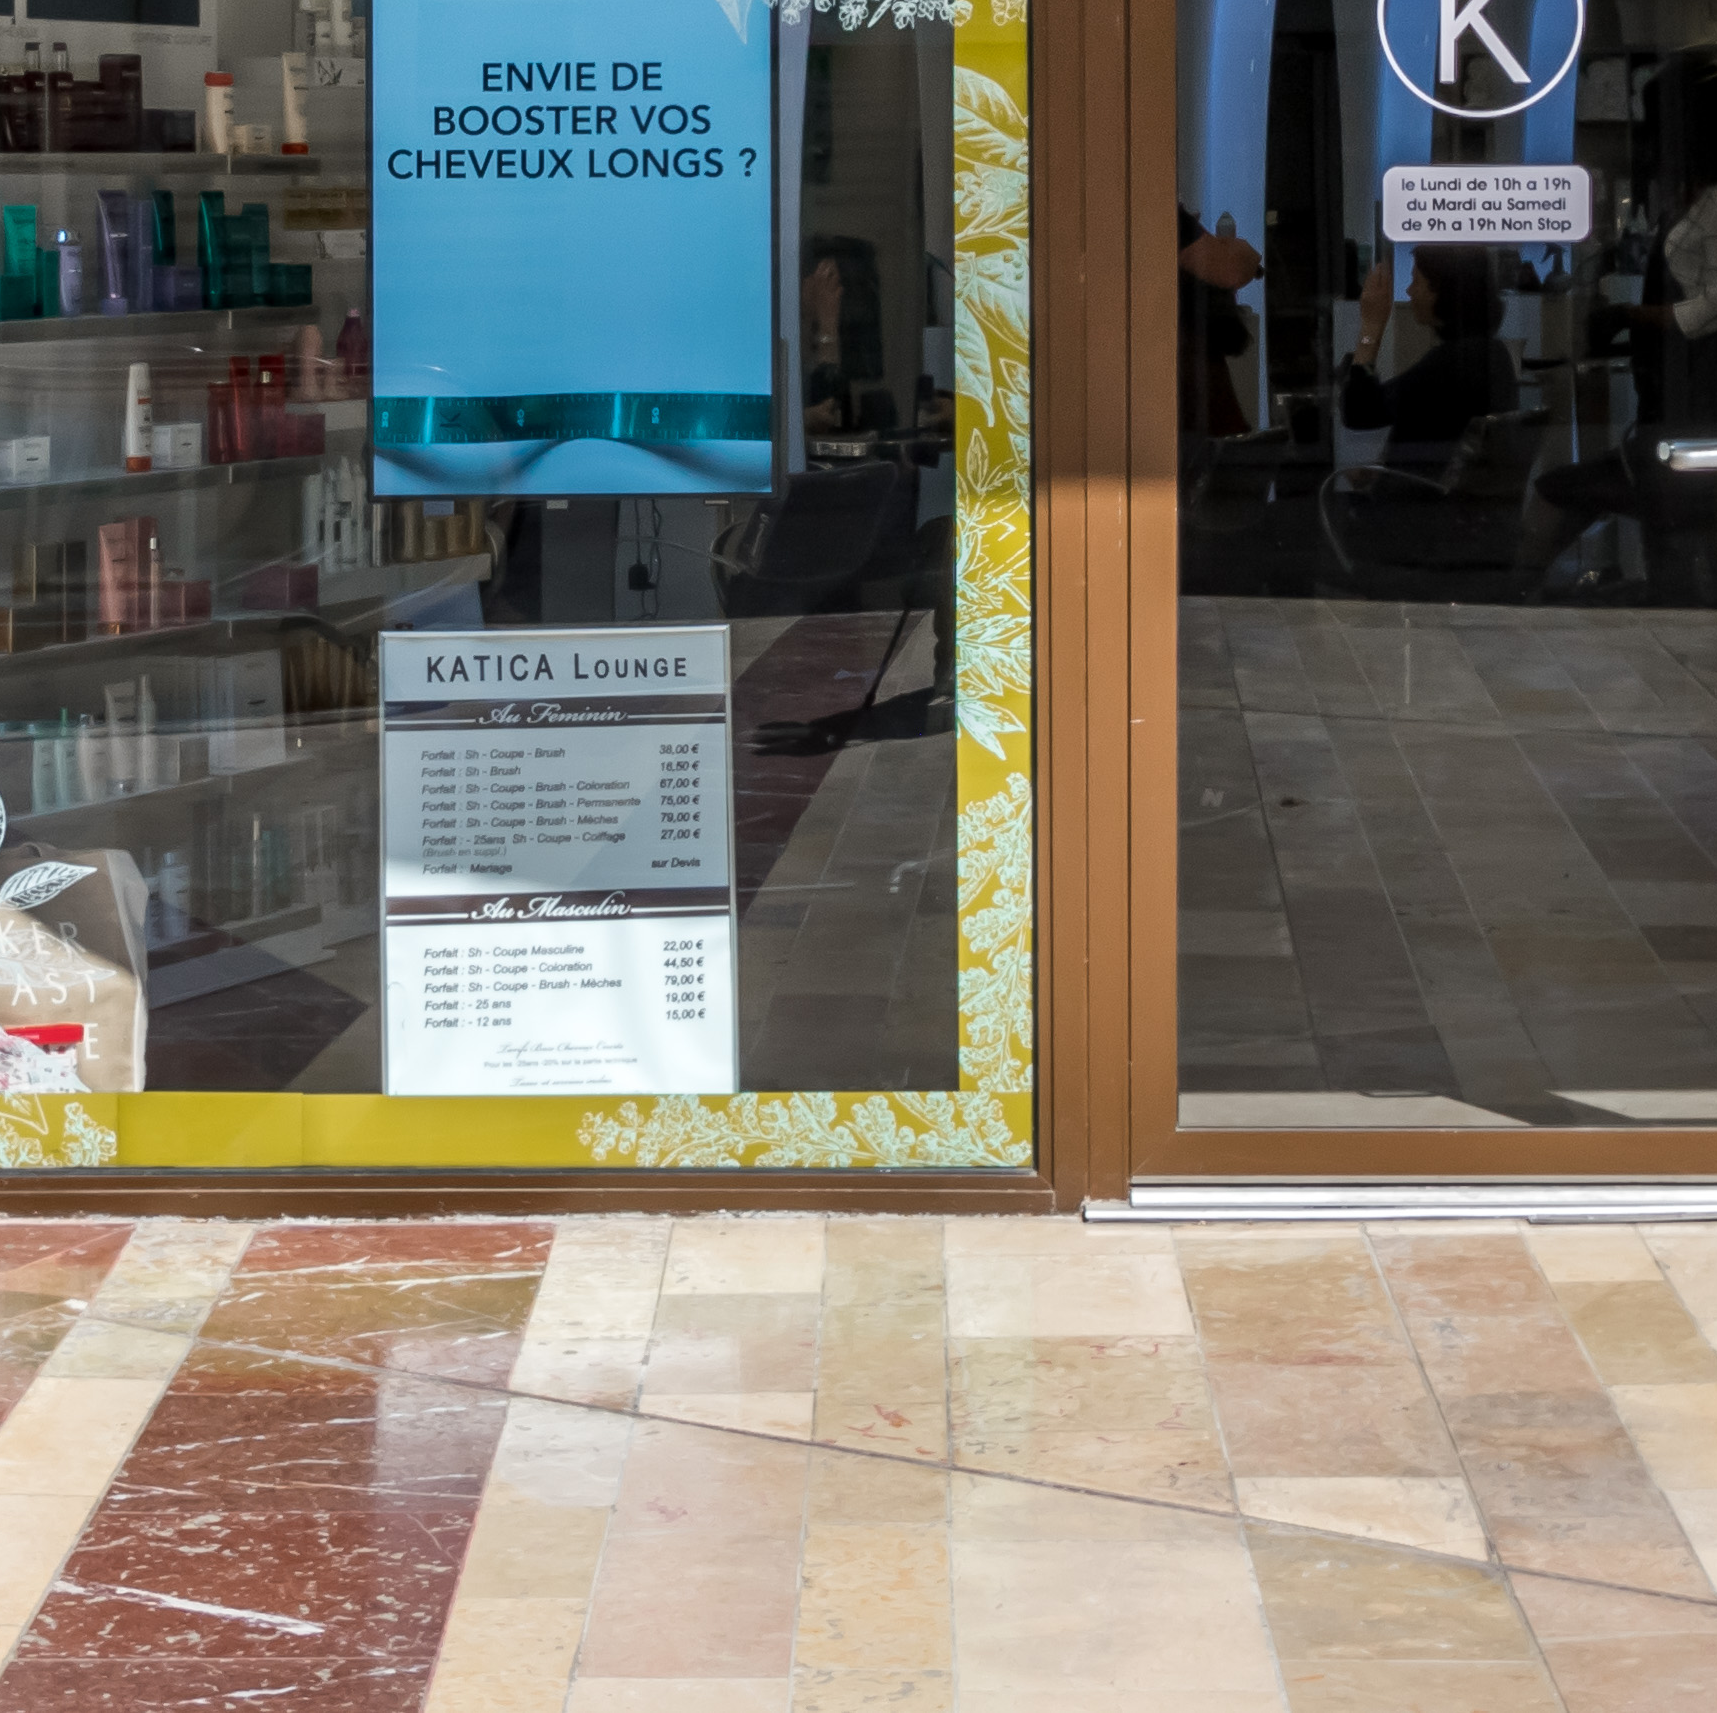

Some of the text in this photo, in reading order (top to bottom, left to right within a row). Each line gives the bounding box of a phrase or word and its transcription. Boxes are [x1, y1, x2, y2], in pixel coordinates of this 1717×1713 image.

[482, 61, 663, 92] ENVIE DE
[433, 104, 712, 136] BOOSTER VOS
[387, 148, 758, 180] CHEVEUX LONGS ?
[1402, 177, 1571, 191] le Lundi de 10h a 19h
[1406, 197, 1566, 211] du Mardi au Samedi
[1402, 217, 1572, 233] de 9h a 19h Non Stop
[427, 653, 687, 683] KATICA LOUNGE
[479, 702, 521, 725] Au
[421, 750, 455, 761] Forfait
[465, 749, 479, 760] Sh
[490, 748, 524, 761] Coupe
[534, 747, 565, 758] Brush
[421, 767, 456, 778] Forfait
[465, 766, 479, 777] Sh
[490, 765, 521, 777] Brush
[421, 784, 456, 795] Forfait
[465, 783, 480, 794] Sh
[490, 782, 525, 795] Coupe
[535, 781, 566, 793] Brush
[422, 801, 456, 812] Forfait
[466, 800, 480, 811] Sh
[490, 799, 525, 812] Coupe
[535, 798, 566, 810] Brush
[422, 818, 456, 829] Forfait
[466, 817, 481, 828] Sh
[490, 816, 526, 829] Coupe
[536, 815, 567, 826] Brush
[422, 835, 456, 846] Forfait
[513, 833, 527, 844] Sh
[537, 832, 571, 844] Coupe
[423, 857, 701, 875] Forfait Mariage sur Devis
[471, 890, 631, 920] Au Masculin
[424, 948, 458, 959] Forfait
[468, 947, 482, 958] Sh
[492, 946, 527, 958] Coupe
[531, 944, 584, 955] Masculine
[663, 940, 693, 952] 22,00
[424, 965, 458, 976] Forfait
[468, 964, 482, 975] Sh
[493, 964, 528, 976] Coupe
[538, 962, 593, 972] Coloration
[424, 983, 458, 993] Forfait
[468, 982, 482, 992] Sh
[493, 981, 528, 993] Coupe
[539, 979, 570, 990] Brush
[424, 1000, 458, 1011] Forfait
[491, 1001, 512, 1009] ans
[424, 1018, 459, 1028] Forfait
[492, 1018, 512, 1026] ans
[666, 1009, 695, 1020] 15,00
